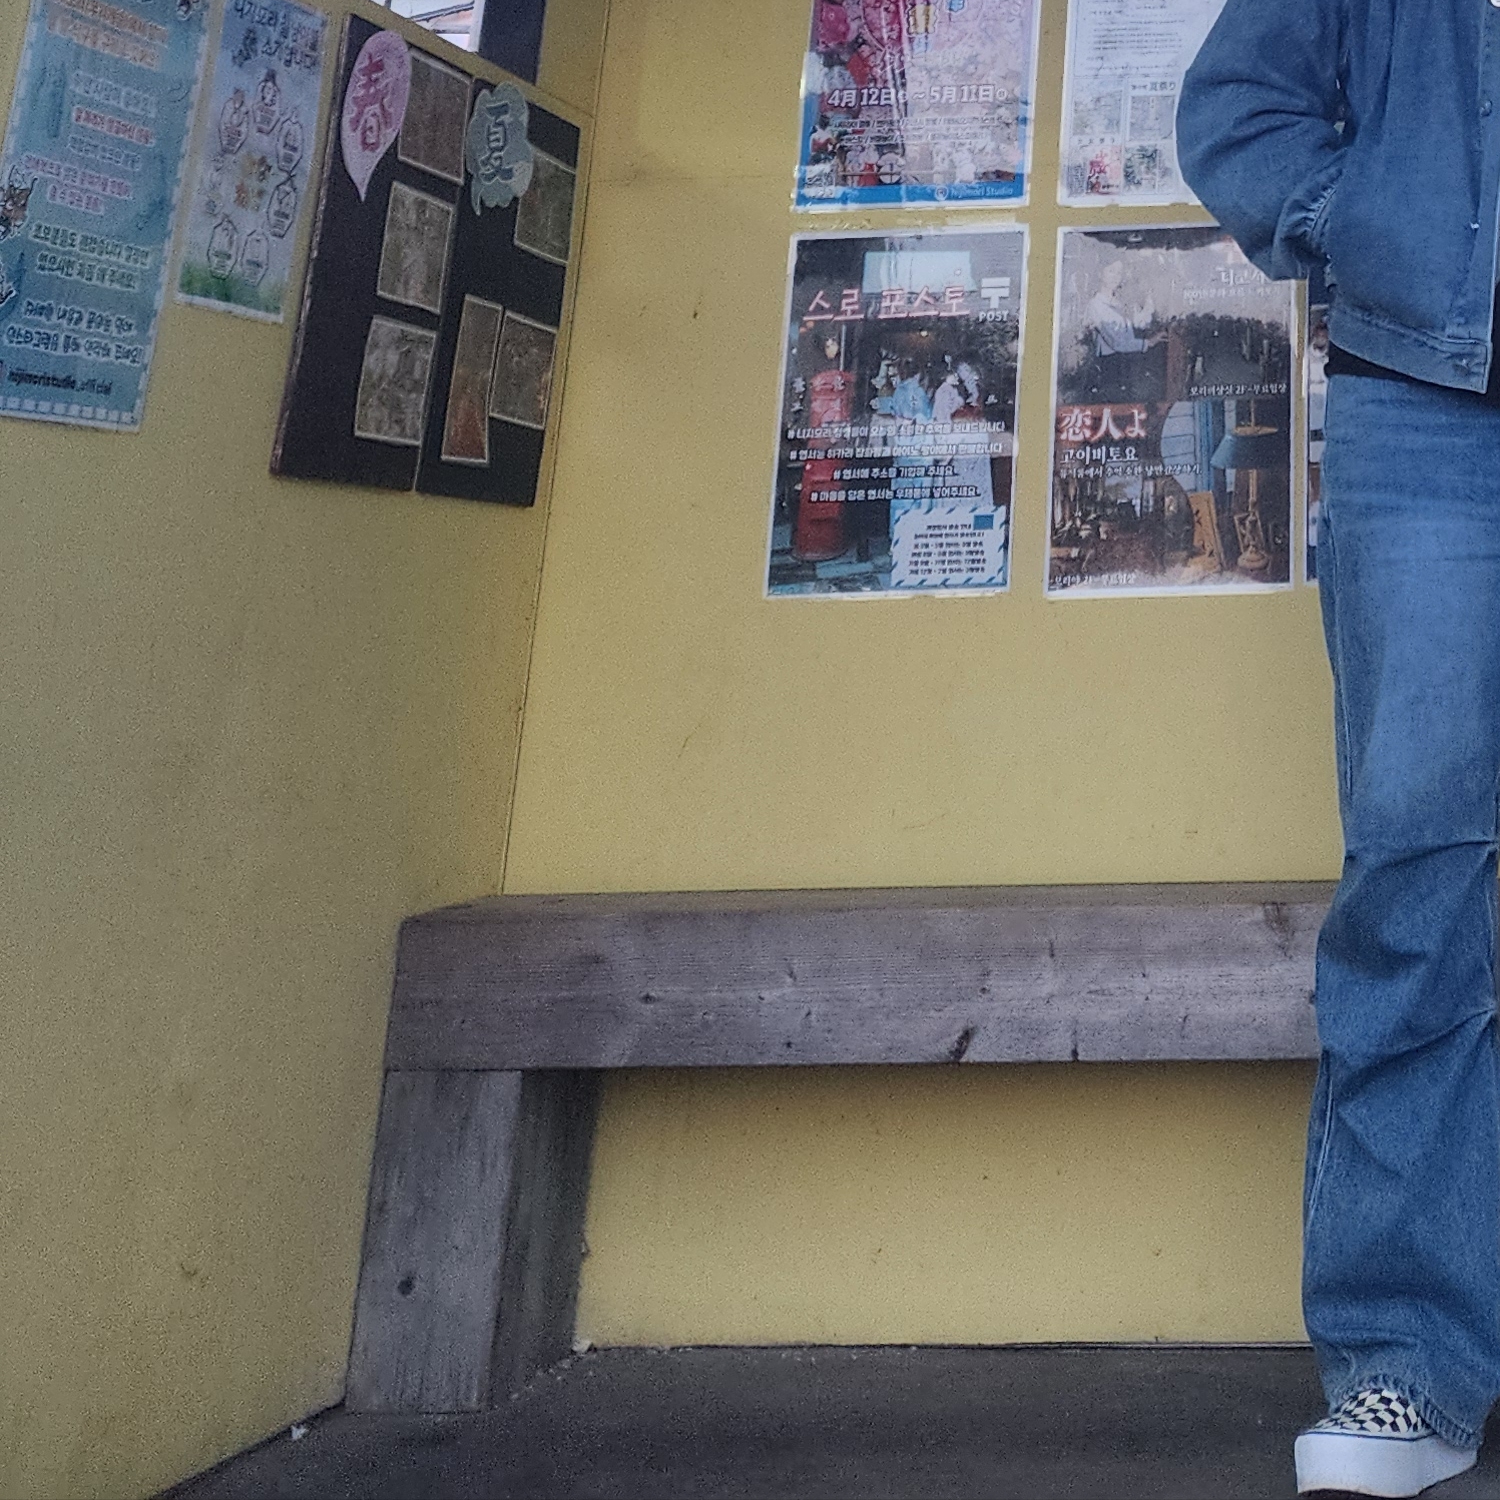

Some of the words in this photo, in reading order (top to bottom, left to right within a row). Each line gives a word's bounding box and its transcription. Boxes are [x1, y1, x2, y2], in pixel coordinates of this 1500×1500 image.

[349, 52, 393, 152] 春
[979, 310, 1010, 323] POST
[1058, 406, 1147, 442] 恋人よ
[1060, 446, 1139, 466] 고이비토요
